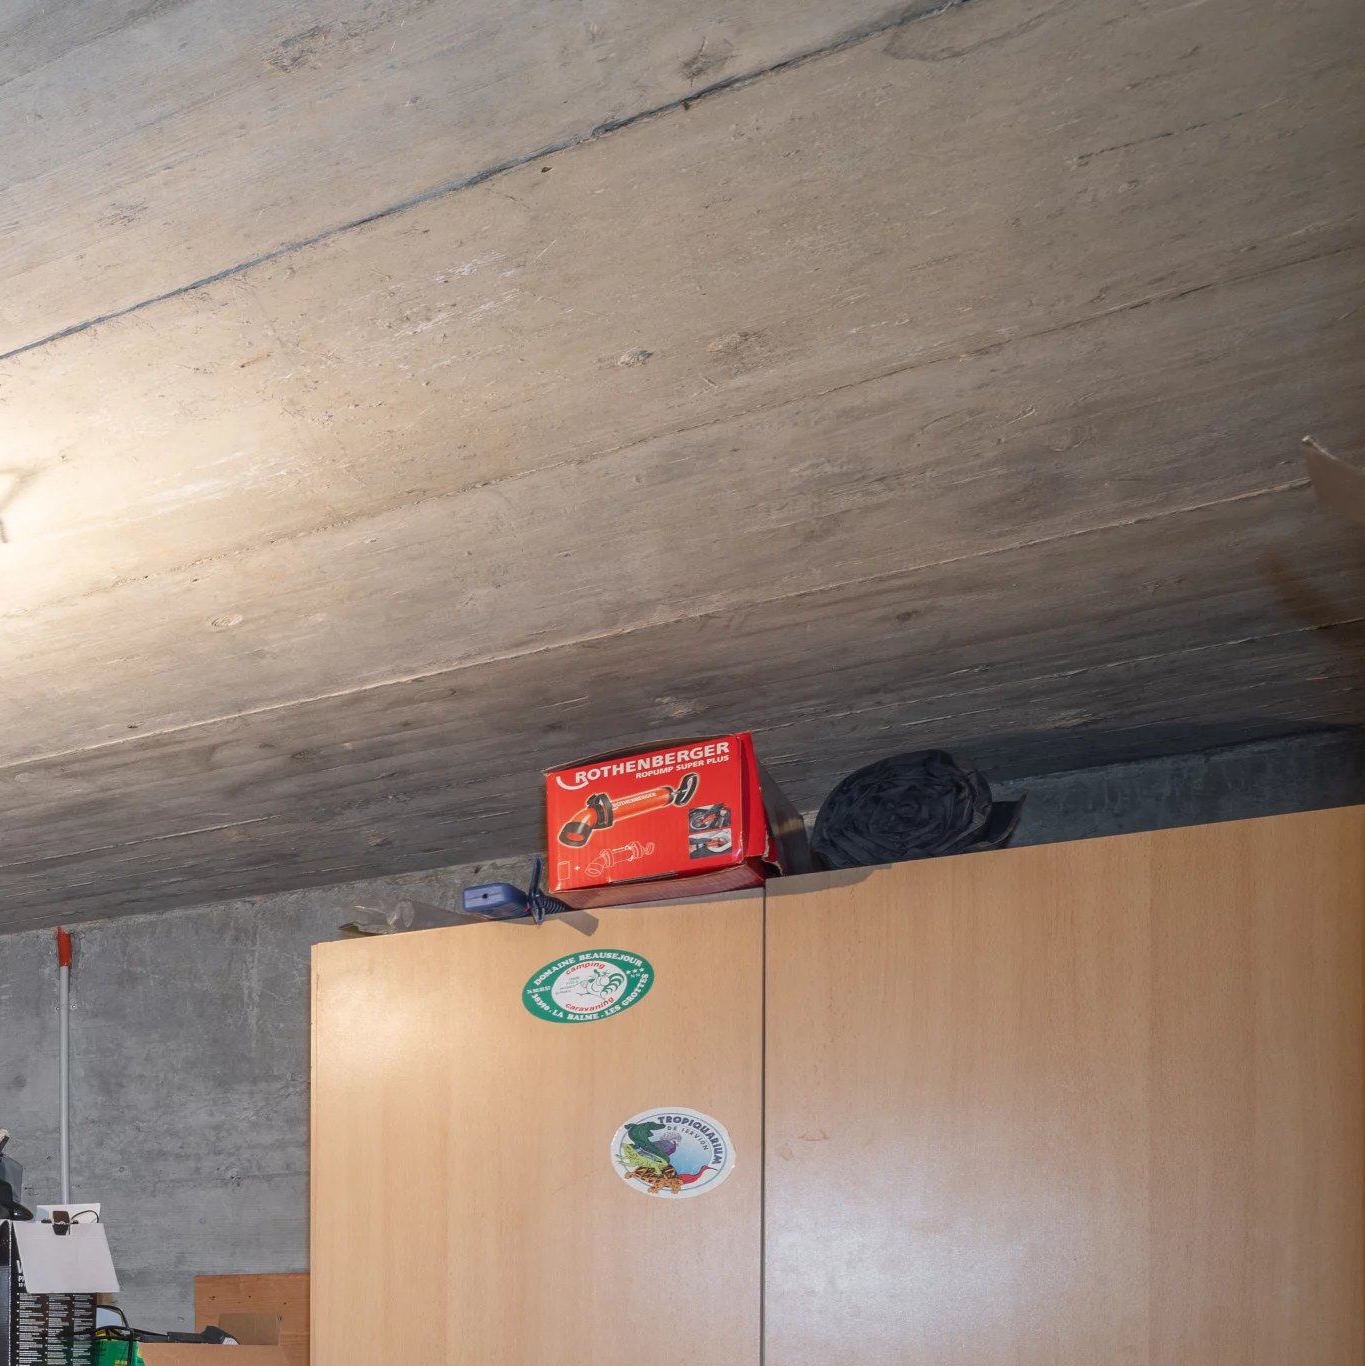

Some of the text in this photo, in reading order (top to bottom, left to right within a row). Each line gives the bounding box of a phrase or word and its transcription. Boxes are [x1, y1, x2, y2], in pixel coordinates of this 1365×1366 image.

[575, 741, 730, 785] ROTHENBERGER
[635, 755, 730, 779] ROPUMP SUPER PLUS
[533, 957, 576, 986] DOMAINE
[578, 951, 643, 967] BEAUSEJOUR
[565, 961, 606, 975] camping
[565, 996, 615, 1012] caravaning
[566, 1012, 600, 1021] BALME
[621, 973, 649, 1006] GROTTES
[657, 1115, 723, 1165] TROPIQUARIUM
